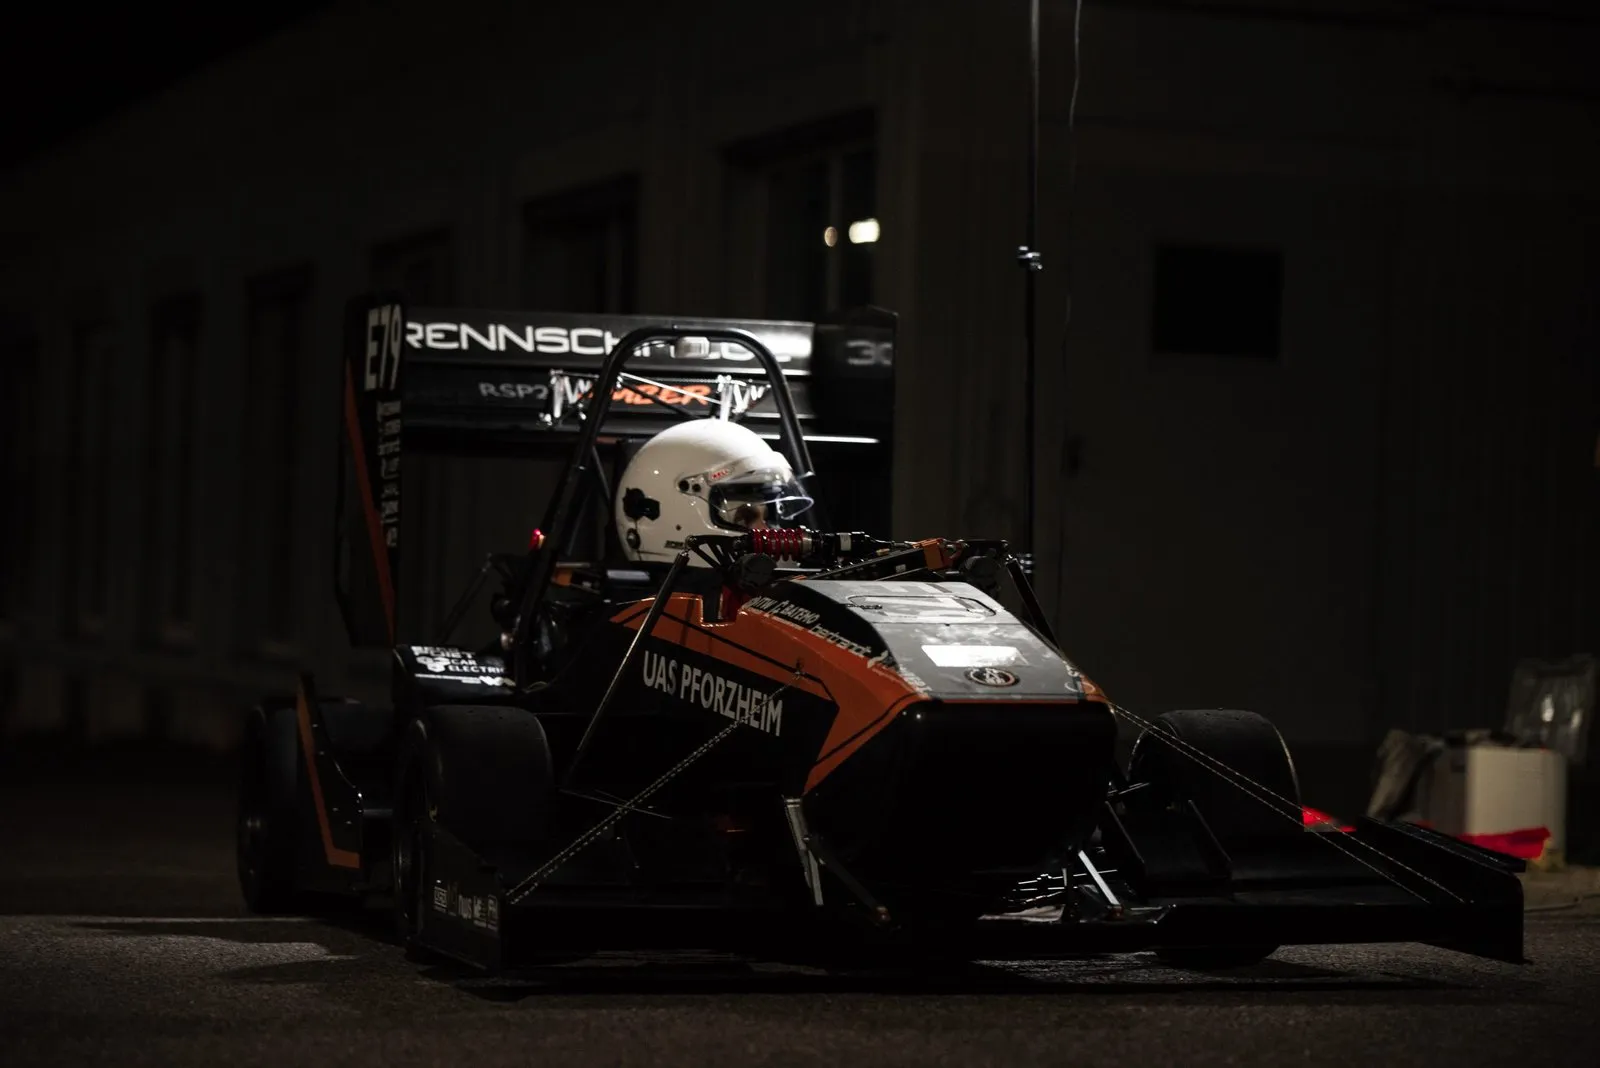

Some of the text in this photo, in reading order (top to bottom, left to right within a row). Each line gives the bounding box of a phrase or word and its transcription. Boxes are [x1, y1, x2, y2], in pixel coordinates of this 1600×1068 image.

[364, 303, 403, 391] E79
[575, 384, 711, 405] MBER
[643, 650, 784, 737] UAS PFORZHEIM
